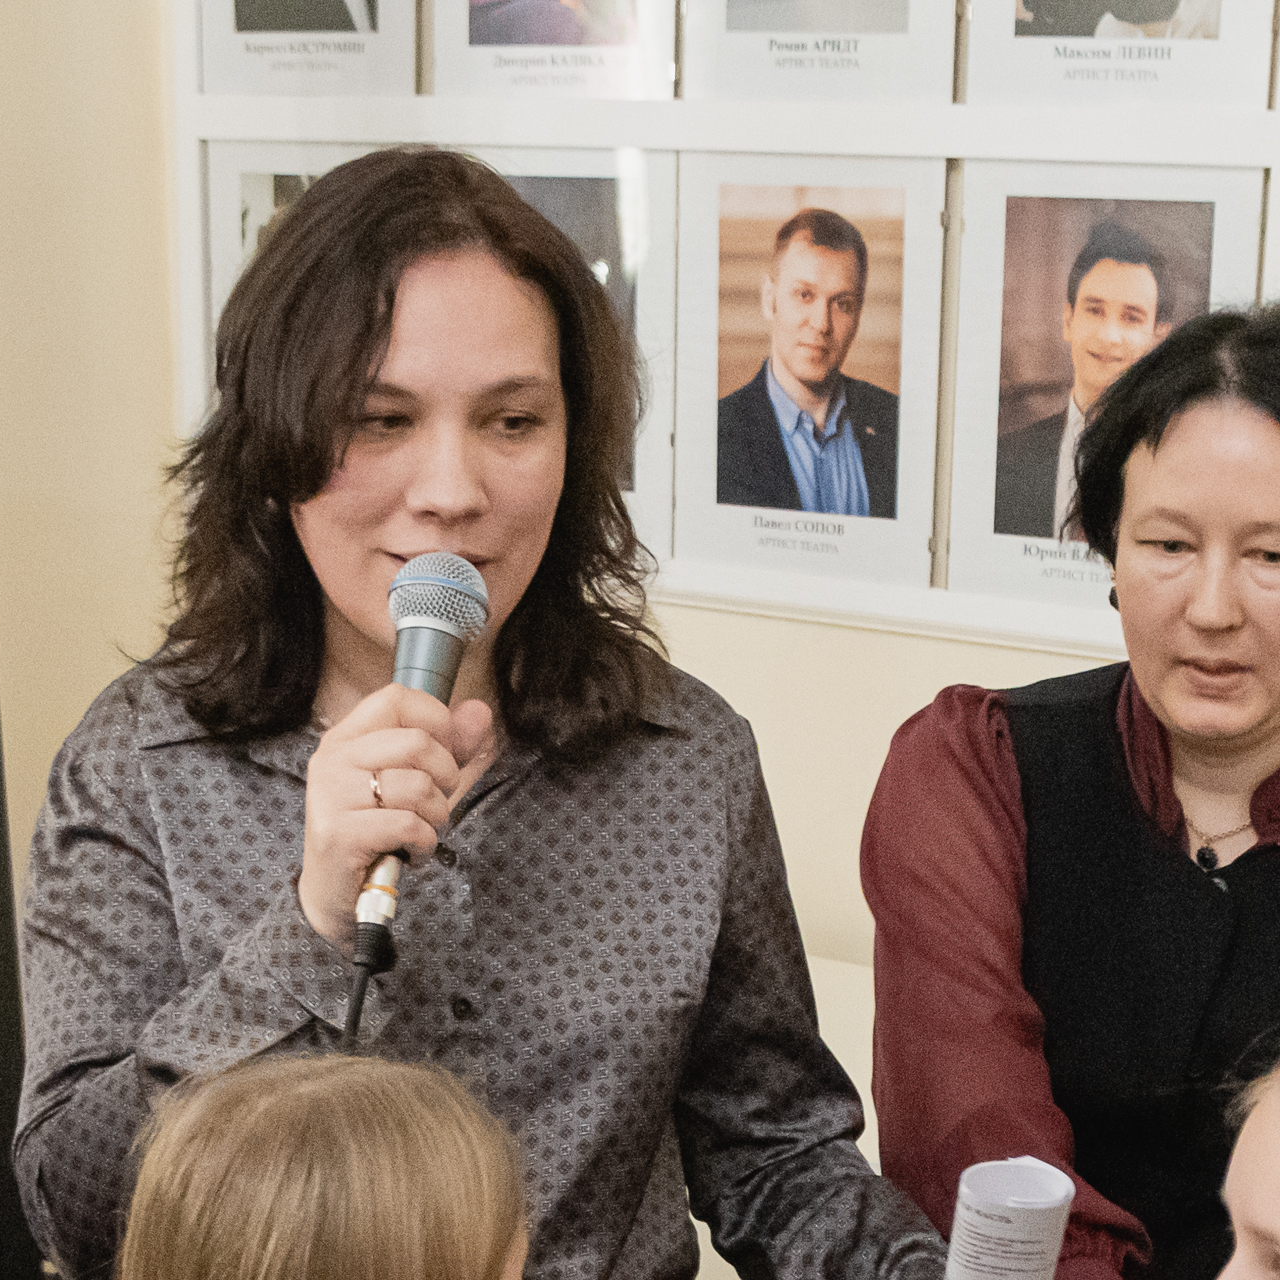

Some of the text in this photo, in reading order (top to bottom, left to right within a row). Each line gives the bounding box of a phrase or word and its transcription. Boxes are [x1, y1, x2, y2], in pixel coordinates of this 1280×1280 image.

[1053, 45, 1172, 61] Максим ЛЕВИН
[1063, 67, 1160, 82] АРТИСТ ТЕАТРА
[753, 515, 846, 537] Павел СОПОВ
[1023, 543, 1067, 562] Юрий
